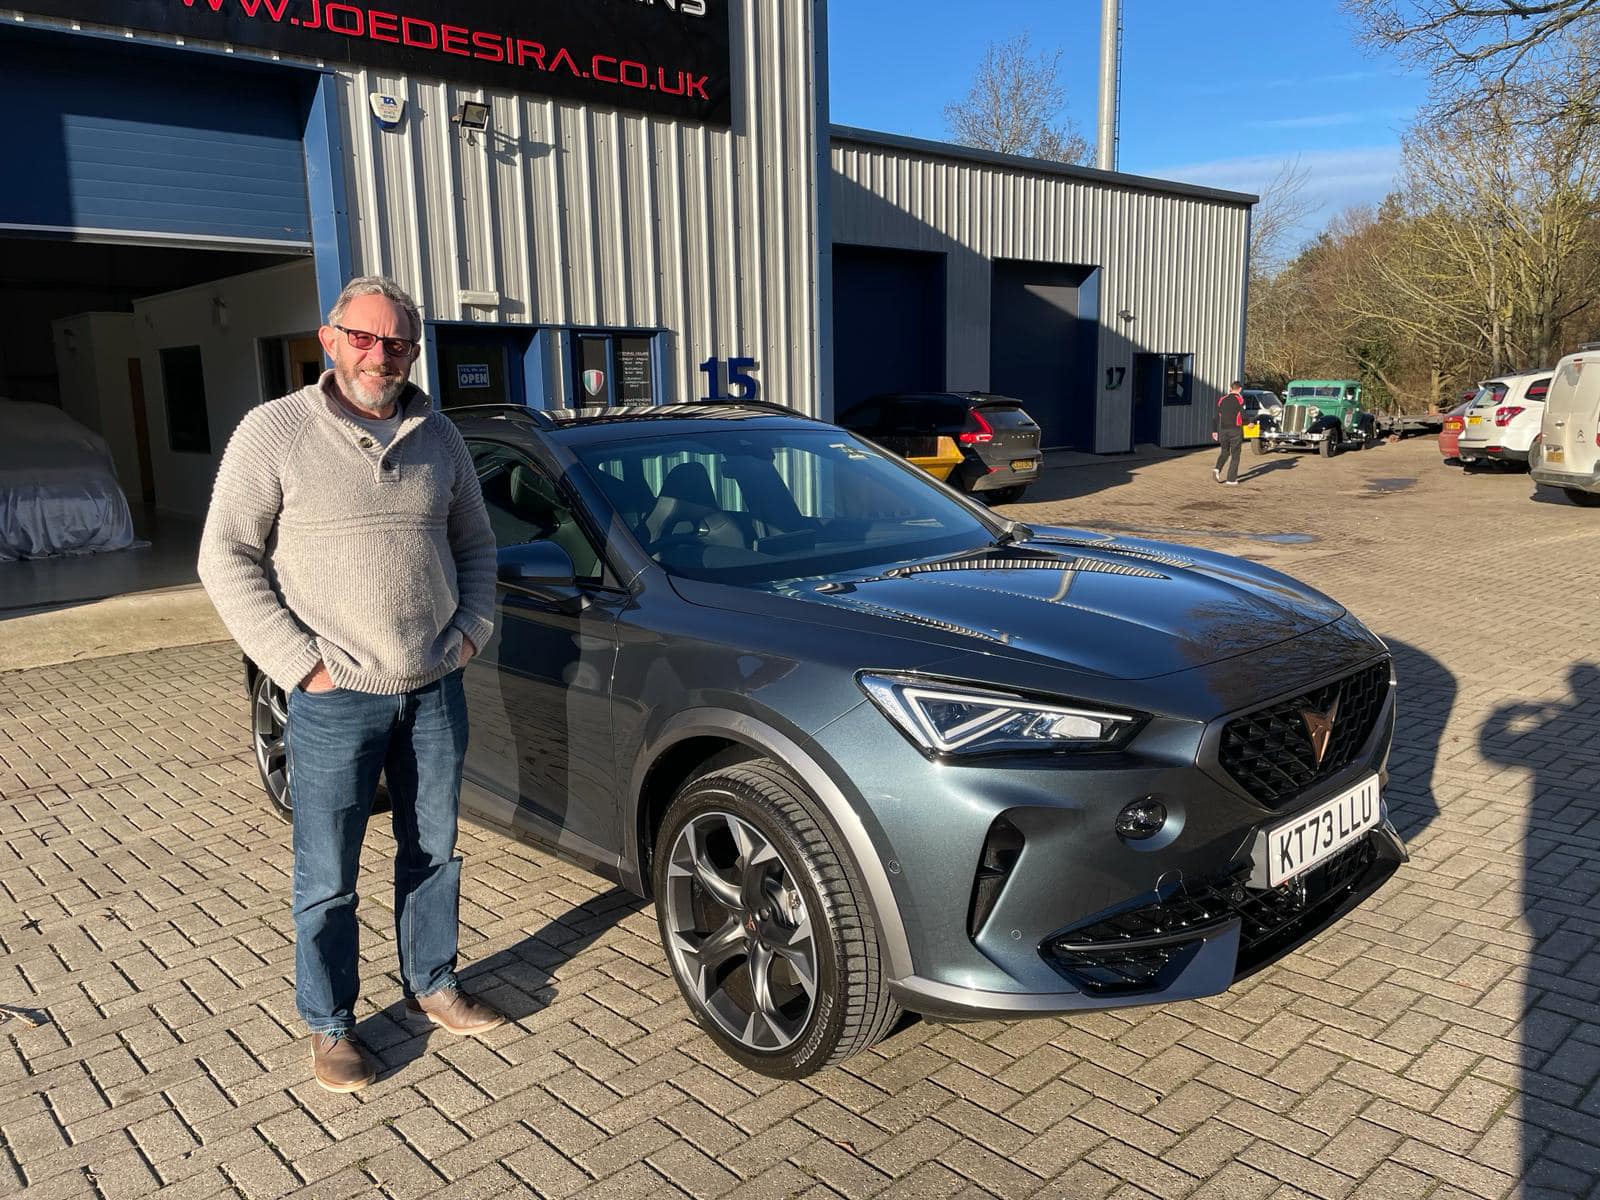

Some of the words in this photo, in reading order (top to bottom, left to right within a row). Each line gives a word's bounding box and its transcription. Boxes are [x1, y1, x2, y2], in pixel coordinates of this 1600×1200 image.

[183, 0, 710, 101] W.JOEDESIRA.CO.UK
[460, 373, 488, 384] OPEN
[699, 356, 757, 401] 15
[1106, 367, 1126, 391] 17
[1280, 809, 1334, 875] KT73
[1339, 785, 1372, 840] LLU
